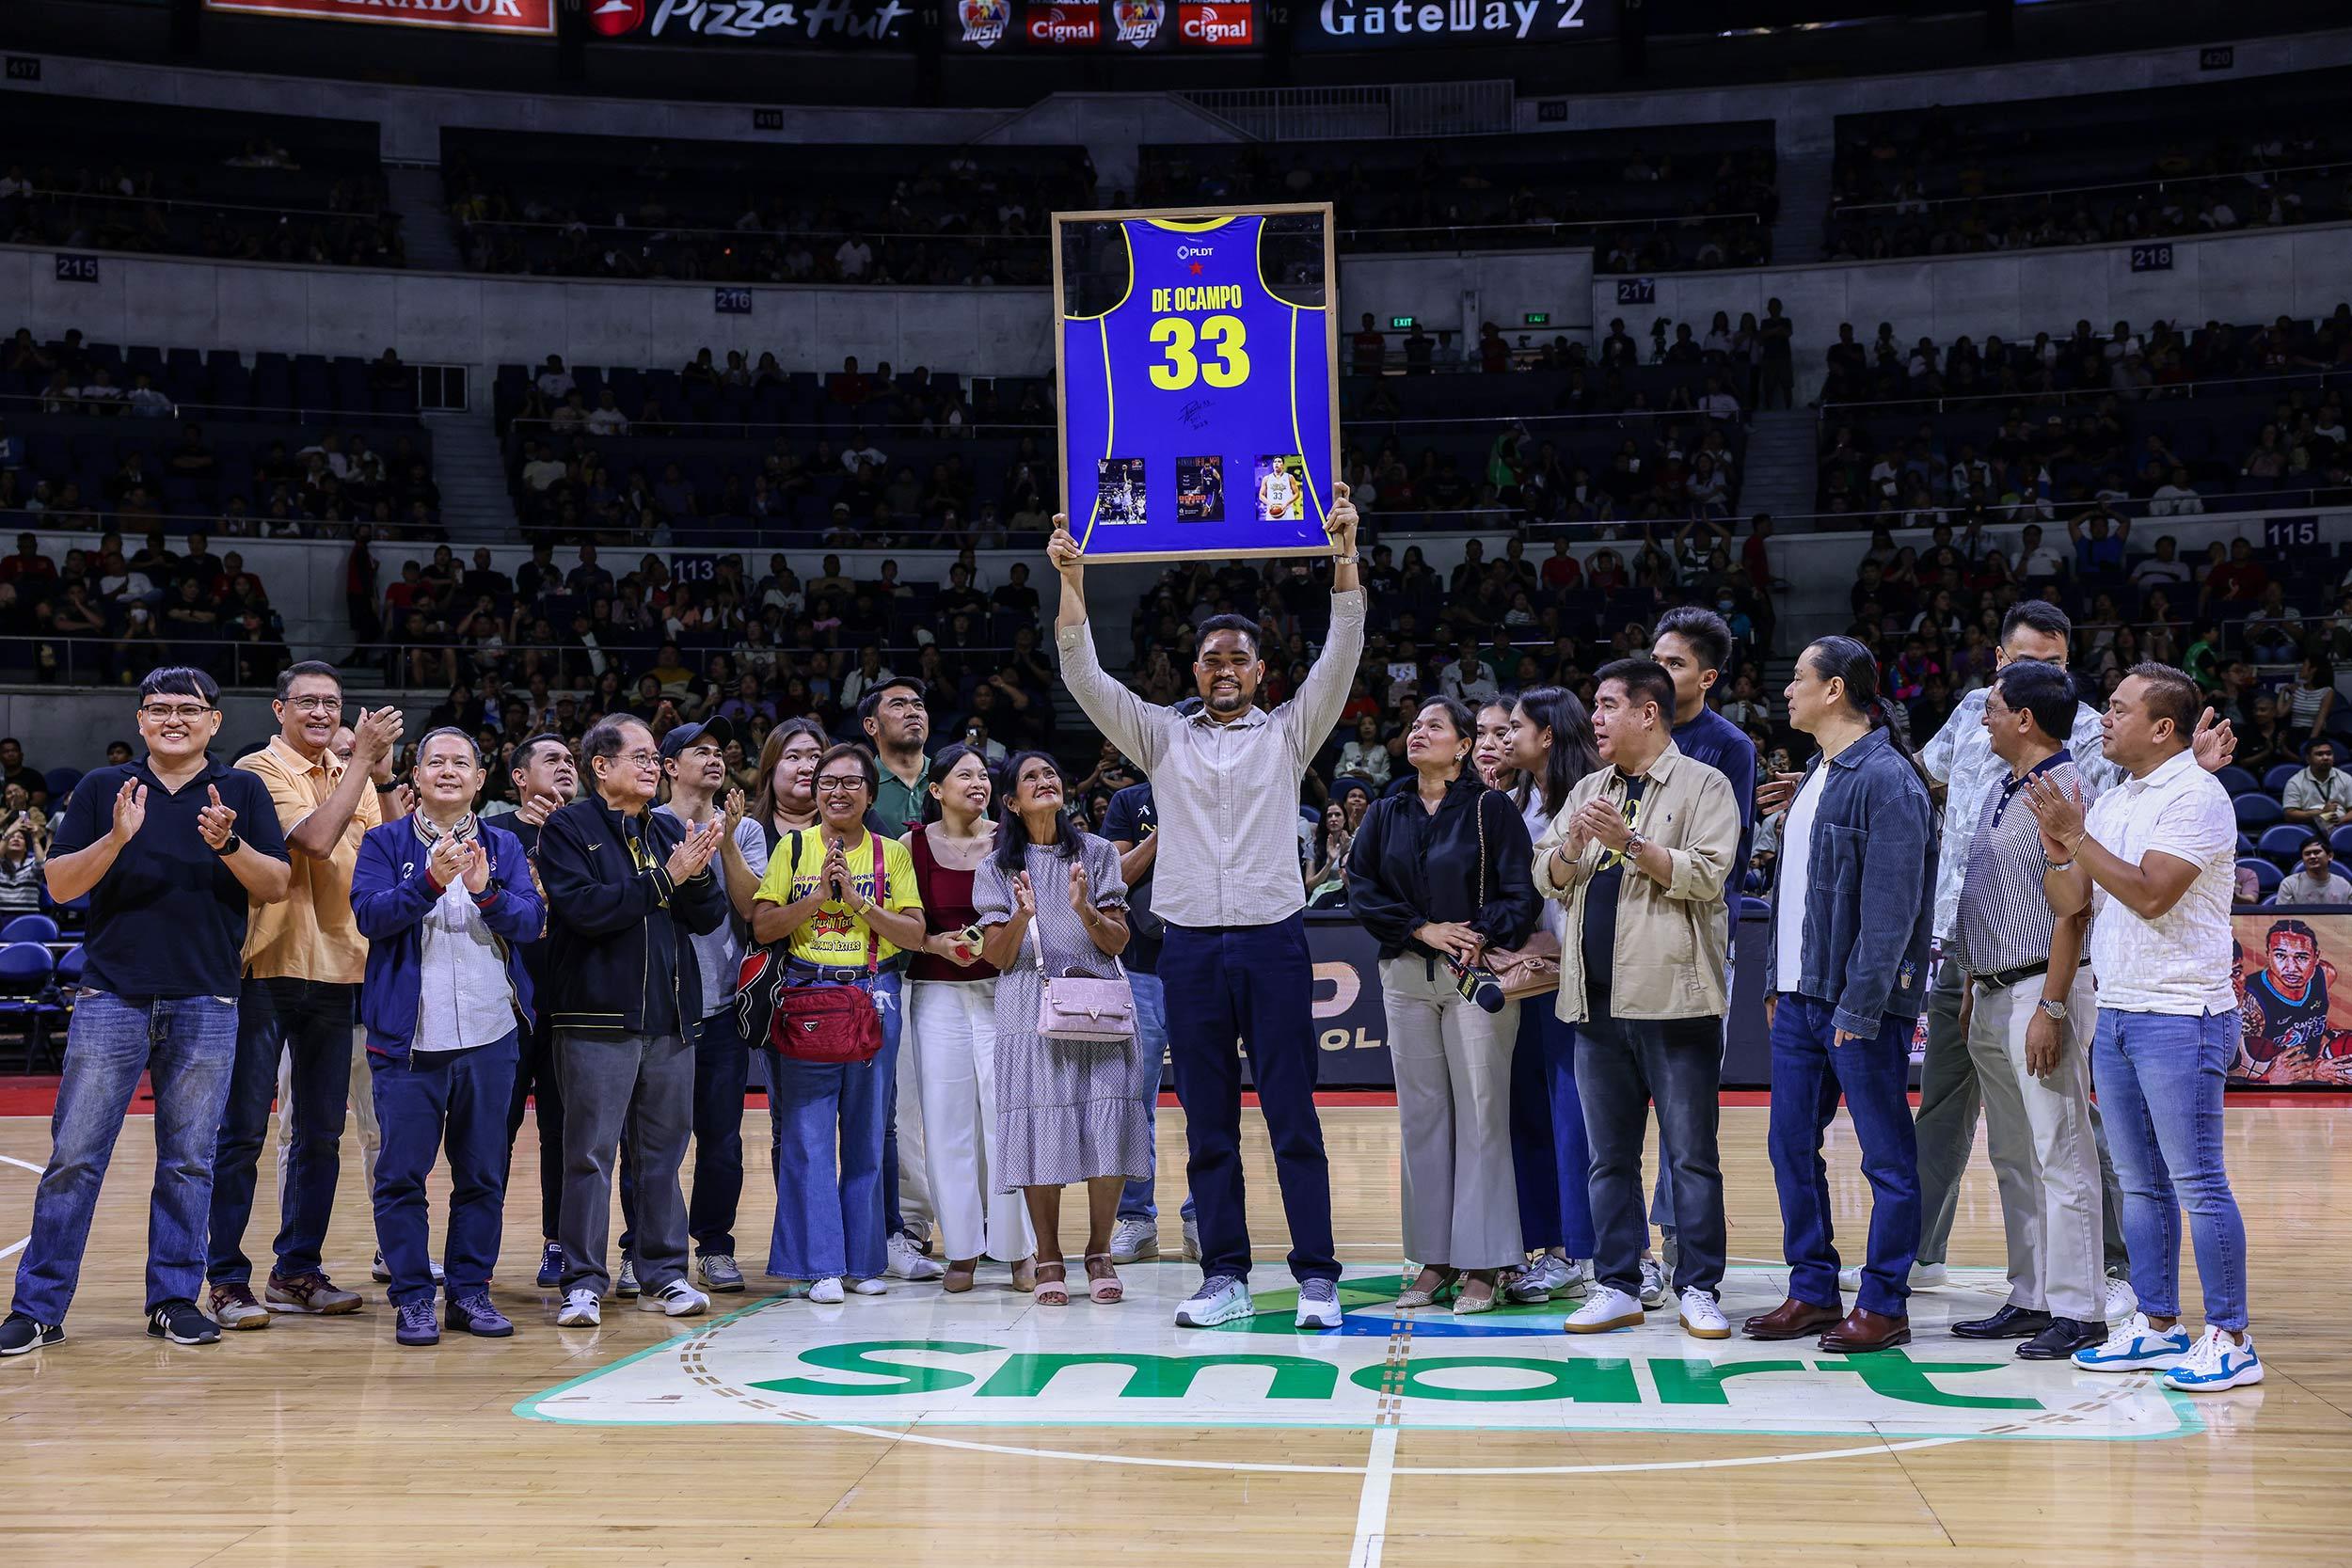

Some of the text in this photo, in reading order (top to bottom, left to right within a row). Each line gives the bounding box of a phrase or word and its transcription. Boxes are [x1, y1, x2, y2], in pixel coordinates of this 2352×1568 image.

[650, 0, 914, 40] Pizza Hut
[1557, 0, 1585, 29] 2
[961, 24, 1004, 41] RUSH
[1032, 20, 1094, 43] Cignal
[1117, 23, 1159, 41] RUSH
[1184, 19, 1247, 42] Cignal
[2203, 51, 2232, 67] 420
[8, 60, 39, 77] 417
[1190, 247, 1214, 256] PLDT
[2134, 247, 2169, 267] 218
[57, 260, 96, 278] 215
[717, 293, 751, 309] 216
[1152, 284, 1243, 312] DE OCAMPO
[1619, 284, 1654, 302] 217
[1393, 317, 1413, 327] EXIT
[1149, 314, 1250, 390] 33
[2268, 522, 2315, 545] 115
[673, 559, 714, 580] 113
[837, 916, 852, 929] TEXT
[834, 941, 861, 951] TEXTERS
[745, 1340, 2046, 1410] smart
